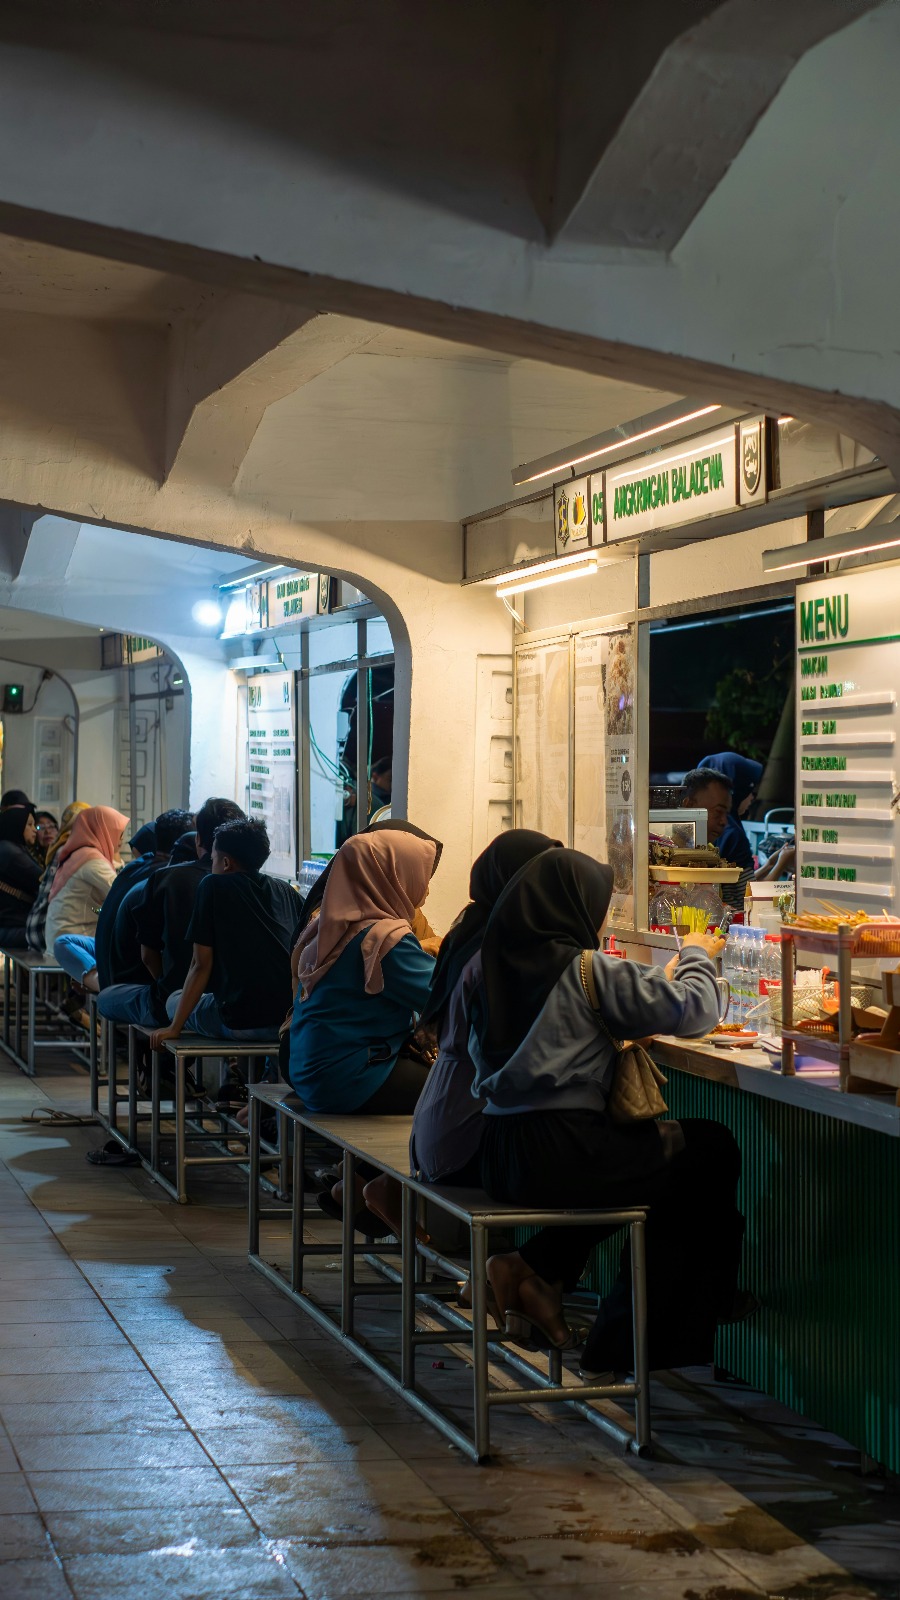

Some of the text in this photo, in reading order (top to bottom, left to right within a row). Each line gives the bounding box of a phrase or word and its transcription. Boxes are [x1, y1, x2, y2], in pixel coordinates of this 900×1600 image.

[613, 470, 669, 520] ANGKRINGAN
[671, 453, 724, 503] BALADEWA
[800, 593, 849, 642] MENU
